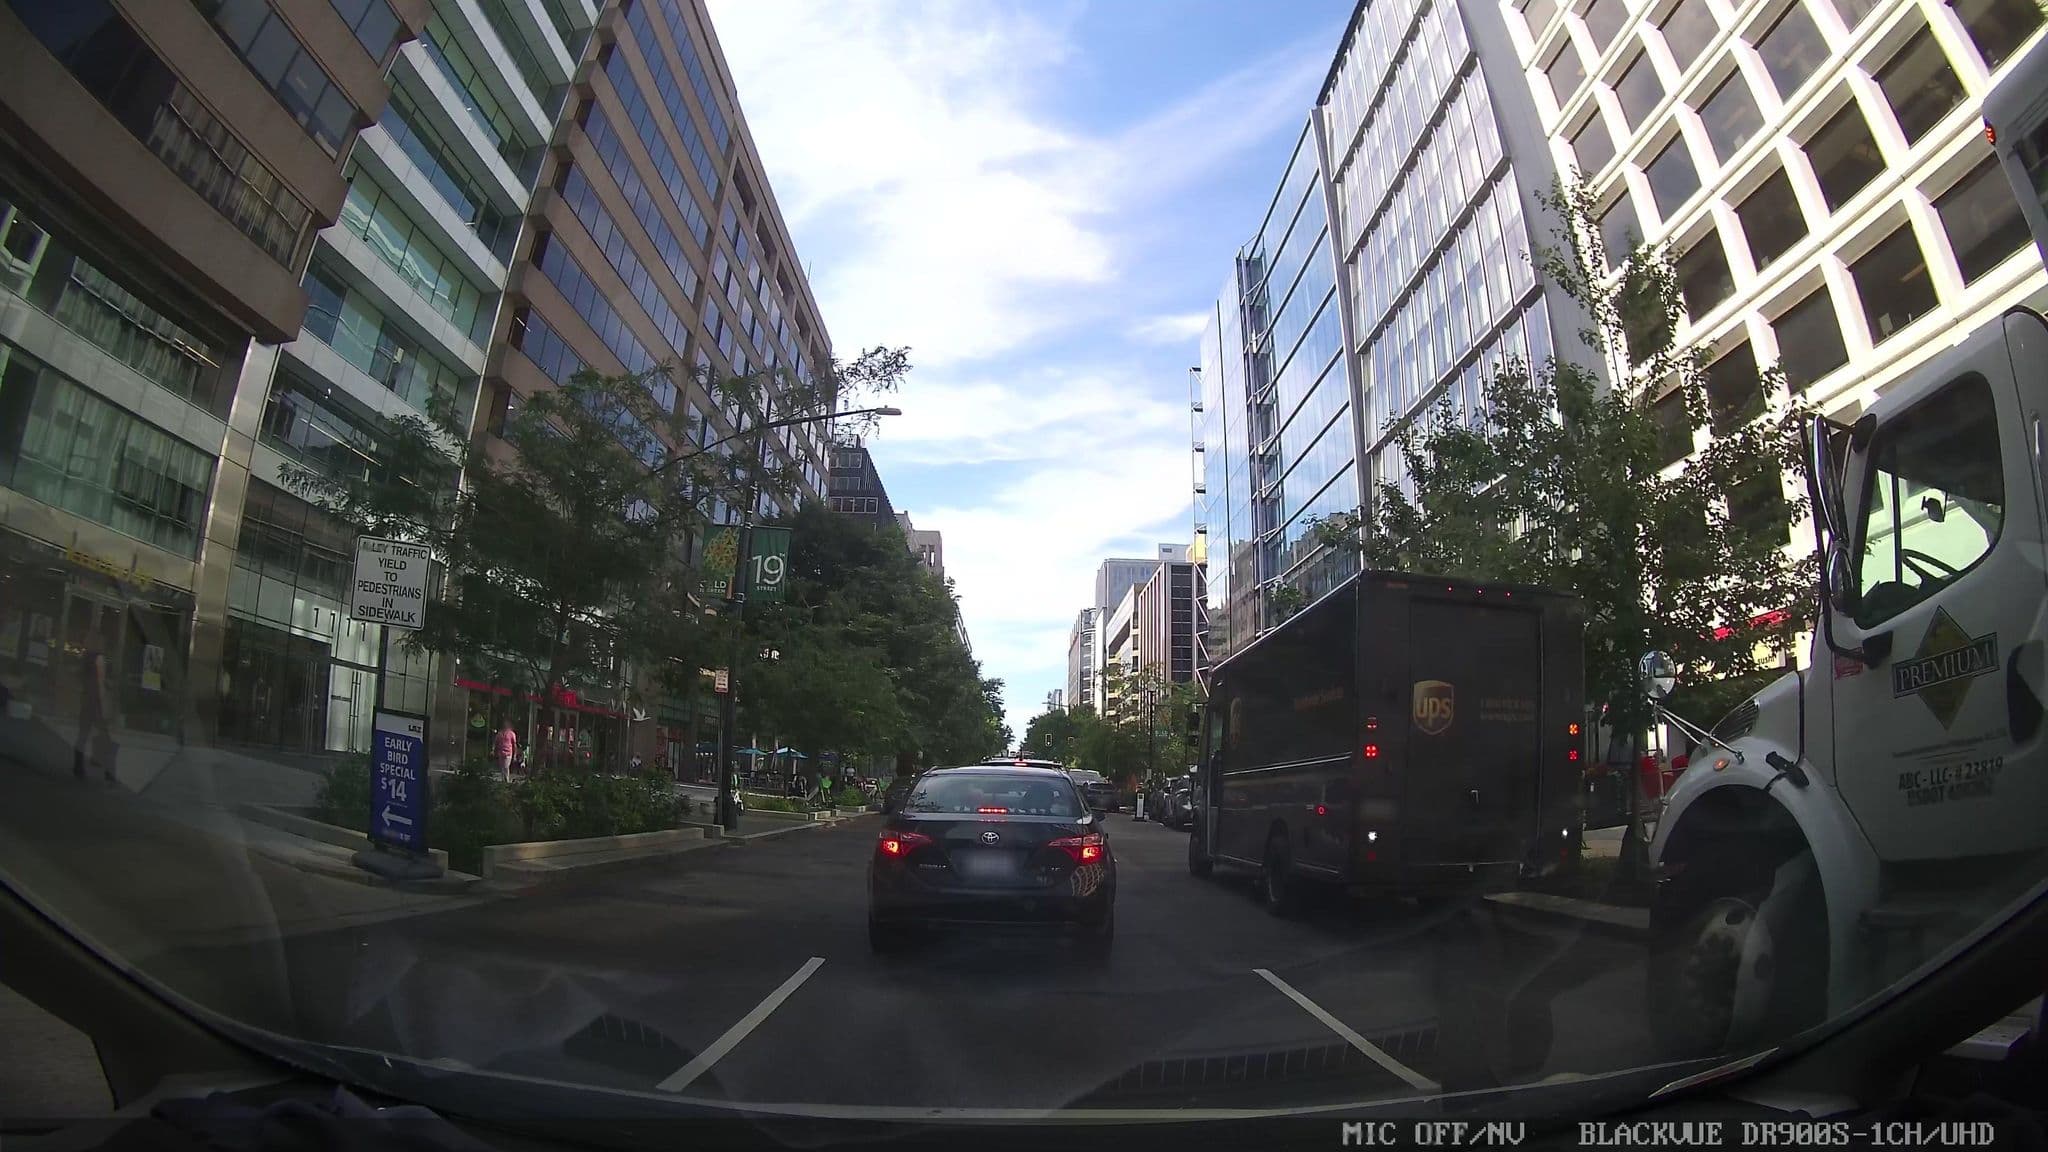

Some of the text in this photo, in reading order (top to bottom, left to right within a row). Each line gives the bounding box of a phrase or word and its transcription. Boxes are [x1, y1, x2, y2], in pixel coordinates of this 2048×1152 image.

[391, 545, 428, 560] TRAFFIC
[379, 557, 407, 571] YIELD
[384, 571, 398, 582] TO
[357, 580, 422, 600] PEDESTRIANS
[382, 598, 394, 609] IN
[358, 605, 416, 623] SIDEWALK
[1900, 640, 1997, 691] PREMIUM
[384, 736, 413, 752] EARLY
[387, 750, 409, 765] BIRD
[380, 762, 416, 780] SPECIAL
[381, 777, 408, 802] $14
